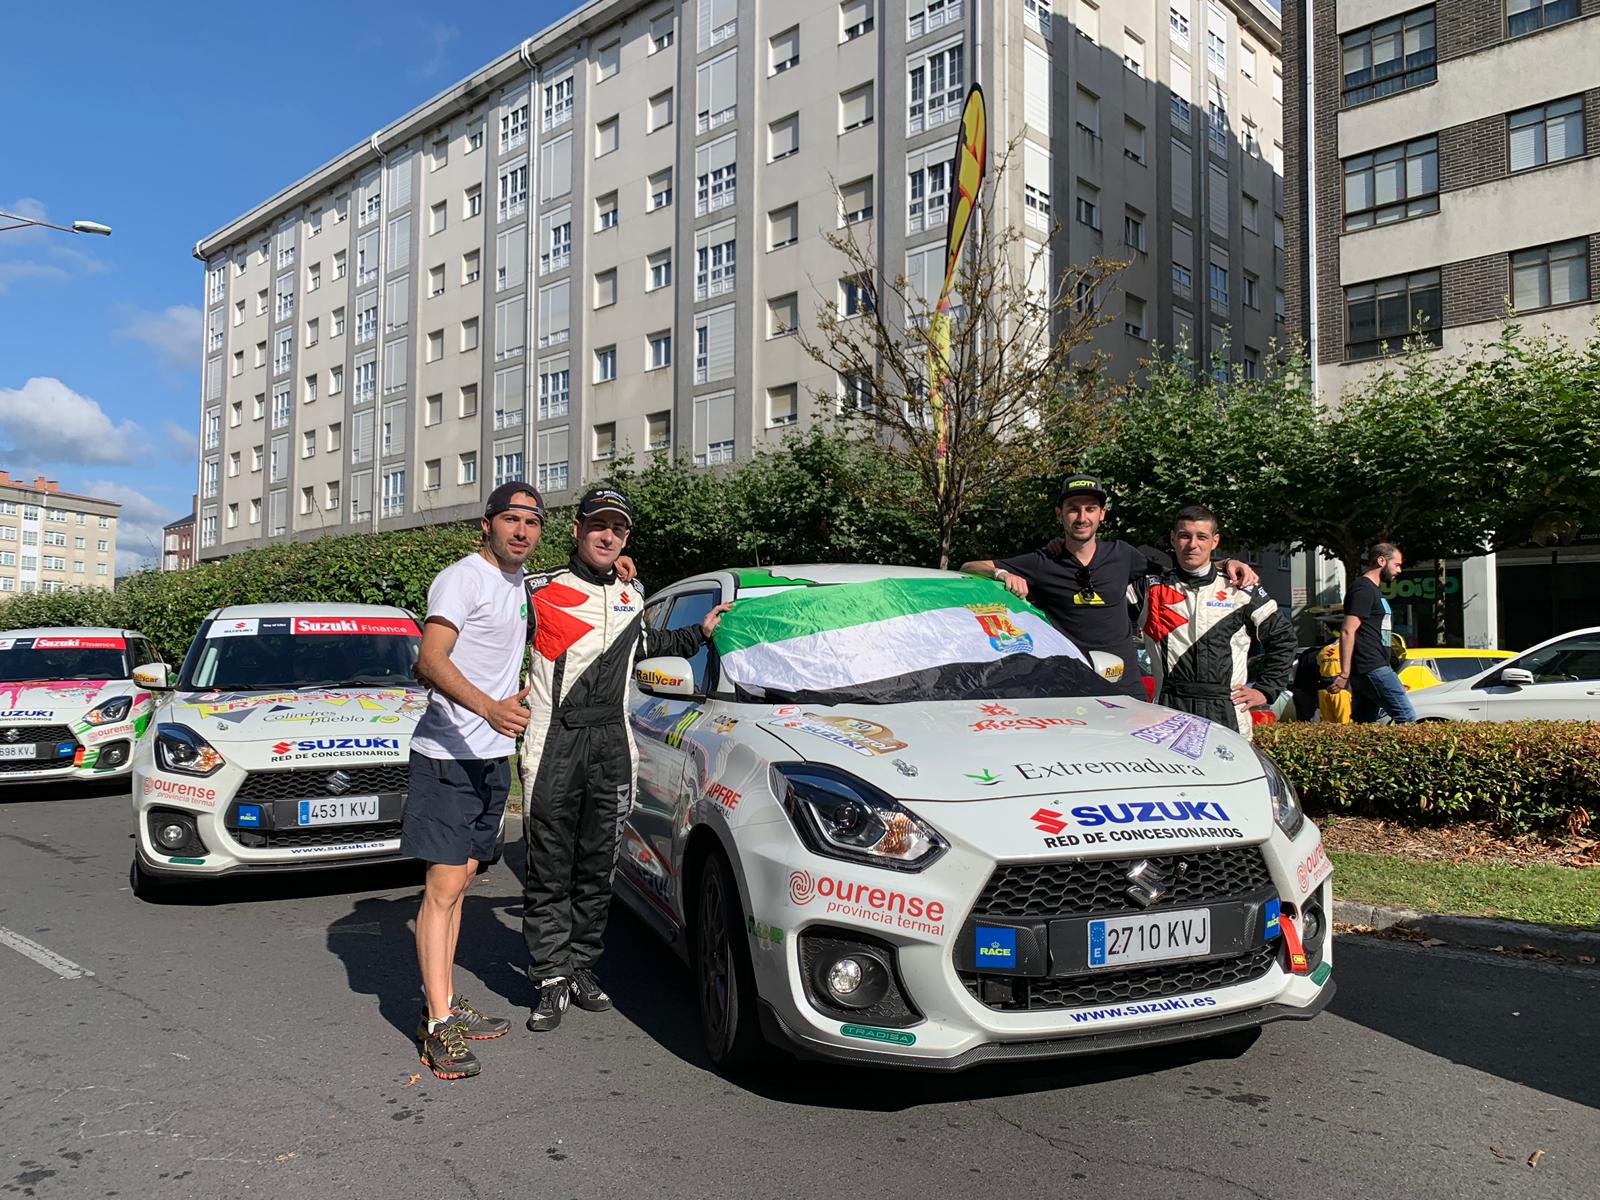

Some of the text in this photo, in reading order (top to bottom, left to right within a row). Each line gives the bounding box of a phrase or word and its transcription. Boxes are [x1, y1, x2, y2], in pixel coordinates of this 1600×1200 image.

[1069, 480, 1096, 488] SCOTT
[1381, 577, 1459, 599] yoigo
[298, 620, 408, 633] Suzuki Finance
[38, 639, 80, 647] Suzuki
[636, 669, 684, 686] Rallycar
[264, 710, 337, 722] Colindres
[310, 715, 365, 725] pueblo
[968, 716, 1088, 732] Regino
[18, 746, 35, 755] KVJ
[298, 738, 399, 751] SUZUKI
[271, 755, 292, 763] RED
[311, 750, 400, 758] CONCESIONARIOS
[1011, 757, 1206, 781] Extremadura
[154, 779, 216, 800] ourense
[156, 792, 216, 807] provincia termal
[311, 803, 345, 819] 4531
[350, 801, 377, 817] KVJ
[1070, 801, 1231, 827] SUZUKI
[1043, 826, 1244, 849] RED DE CONCESIONARIOS
[291, 842, 385, 854] www.suzuki.es
[817, 875, 945, 922] ourense
[826, 900, 945, 937] provincia termal
[1107, 926, 1162, 957] 2710
[1167, 917, 1207, 948] KVJ
[980, 948, 1012, 956] RACE
[1069, 994, 1218, 1023] www.suzuki.es
[847, 1026, 910, 1043] TRADISA
